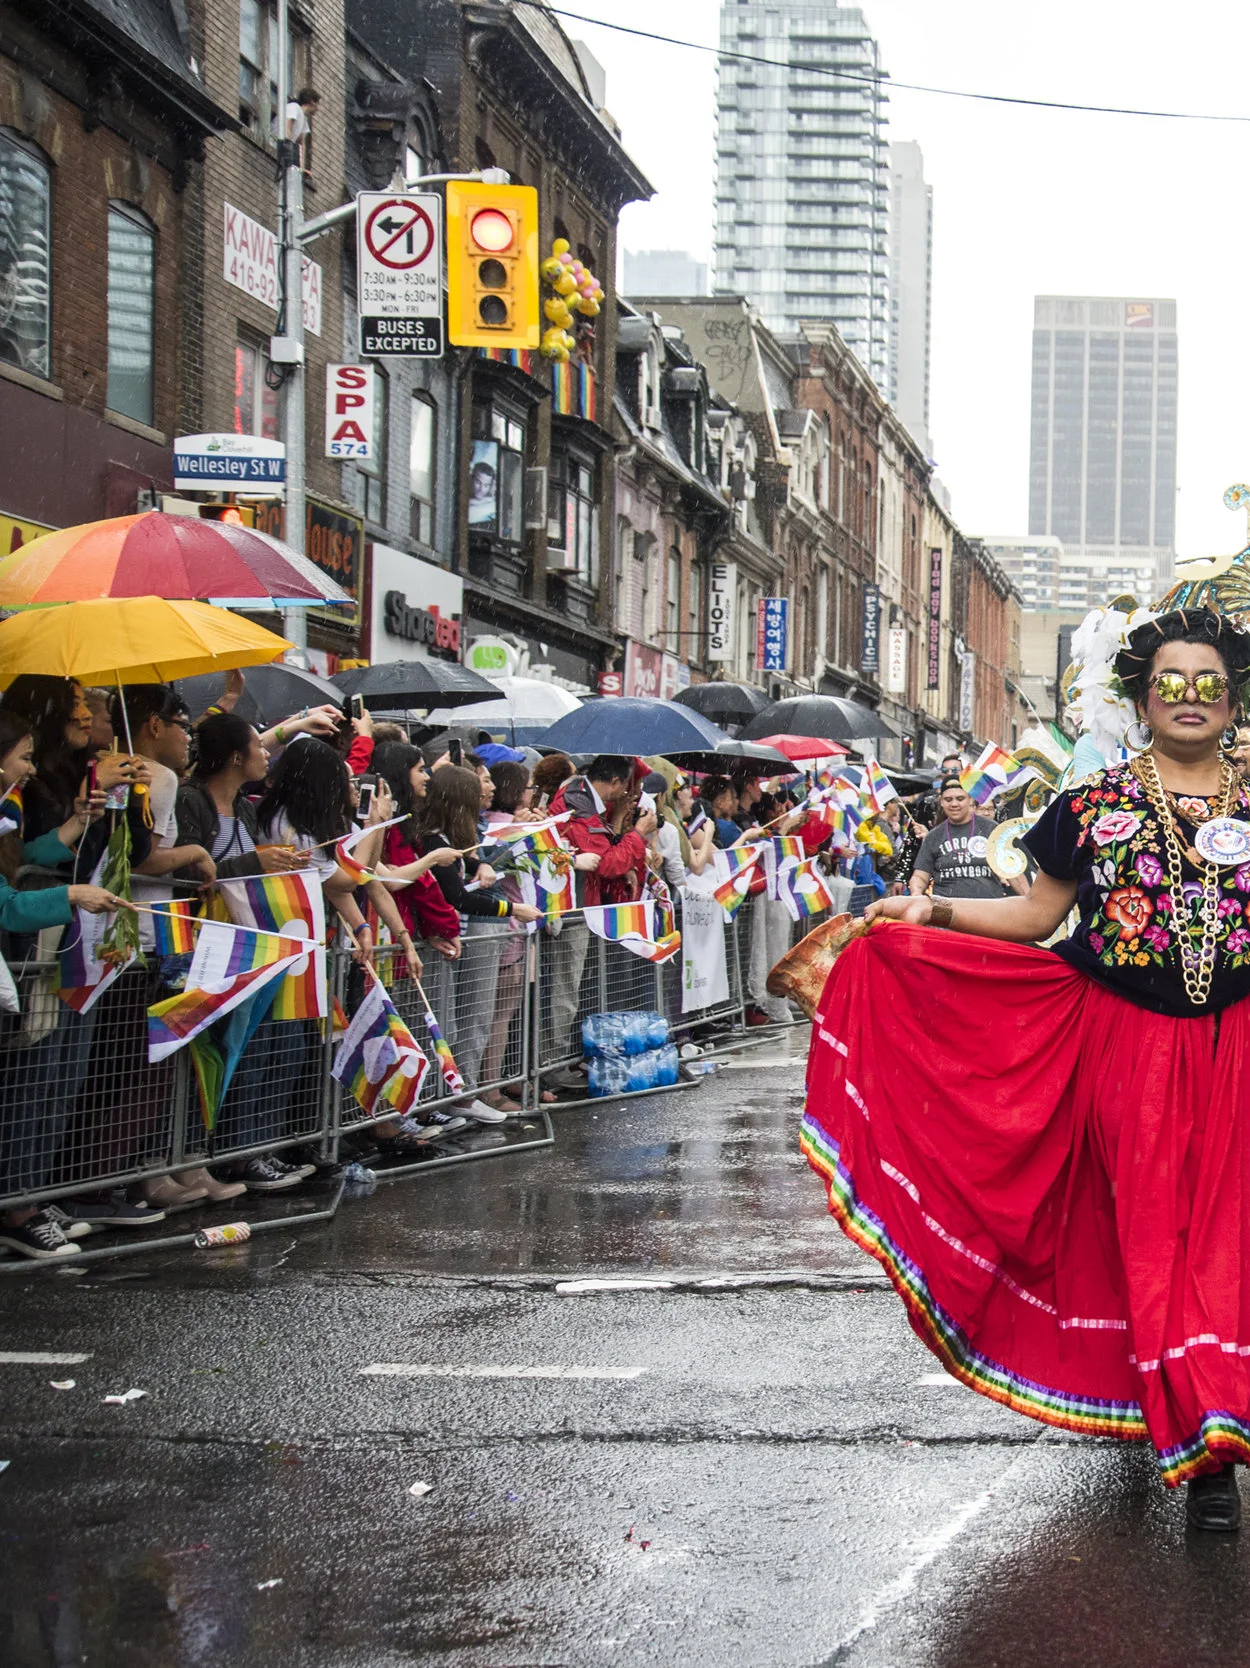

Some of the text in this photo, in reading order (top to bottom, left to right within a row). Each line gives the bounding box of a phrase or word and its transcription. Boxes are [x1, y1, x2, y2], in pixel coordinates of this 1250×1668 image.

[226, 207, 319, 303] KAWA PA
[381, 305, 400, 313] MON
[406, 306, 420, 314] FRI
[365, 336, 437, 351] EXCEPTED
[377, 321, 425, 335] BUSES
[331, 367, 368, 443] SPA
[177, 456, 281, 477] Wellesley St W
[331, 443, 369, 456] 574
[711, 564, 728, 650] ELIOTS
[766, 600, 782, 670] 세방여행사
[864, 595, 877, 656] PSYCHIC
[893, 631, 903, 678] MASSAGE
[939, 837, 968, 855] TORO
